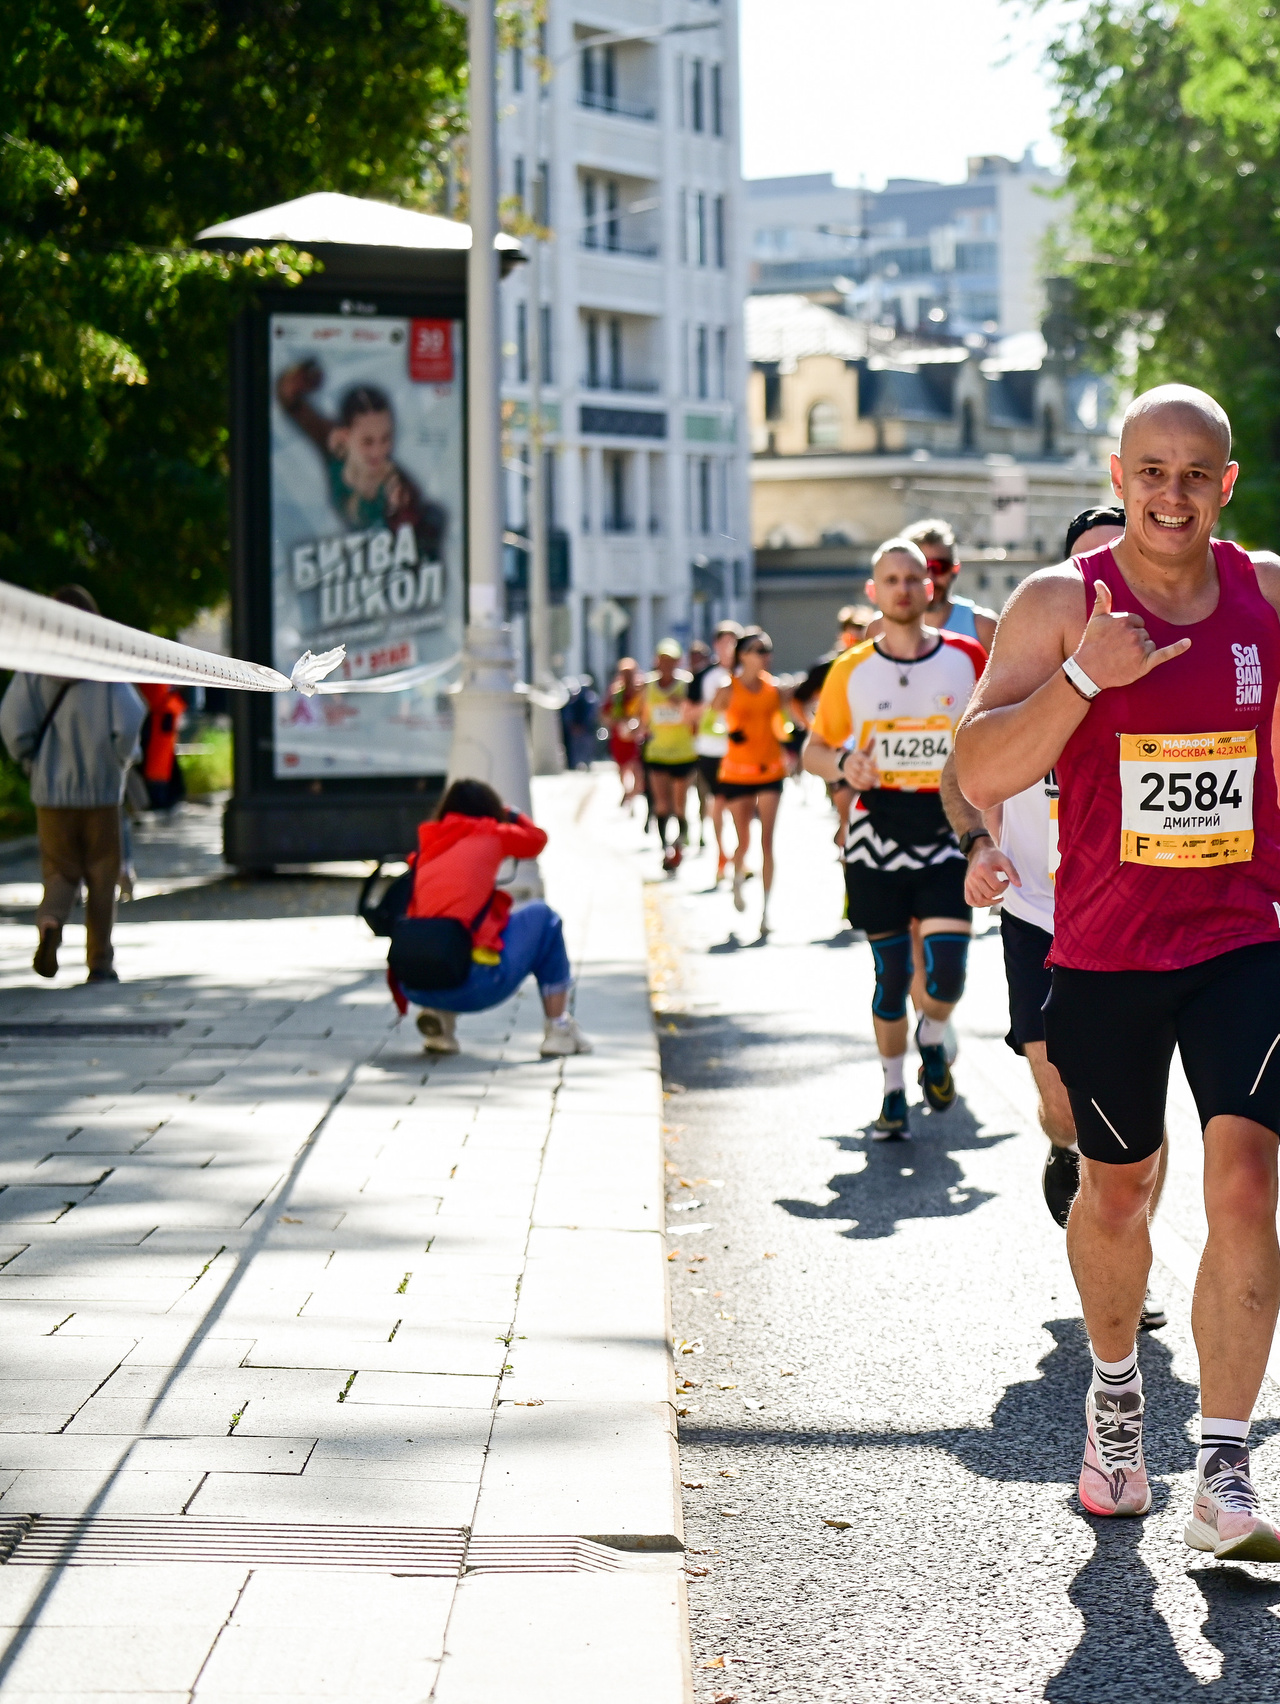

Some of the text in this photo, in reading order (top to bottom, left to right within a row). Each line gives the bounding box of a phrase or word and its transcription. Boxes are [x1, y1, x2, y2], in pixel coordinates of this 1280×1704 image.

[294, 522, 418, 590] БИТВА
[321, 563, 443, 625] ШКОЛ
[1231, 643, 1261, 667] Sat
[1235, 666, 1263, 686] 9AM
[1235, 685, 1263, 705] 5KM
[881, 737, 948, 758] 14284
[1163, 738, 1215, 749] МАРАФОН
[1163, 748, 1207, 757] МОСКВА
[1140, 770, 1242, 812] 2584
[1163, 813, 1220, 829] ДМИТРИЙ
[1137, 836, 1150, 856] F
